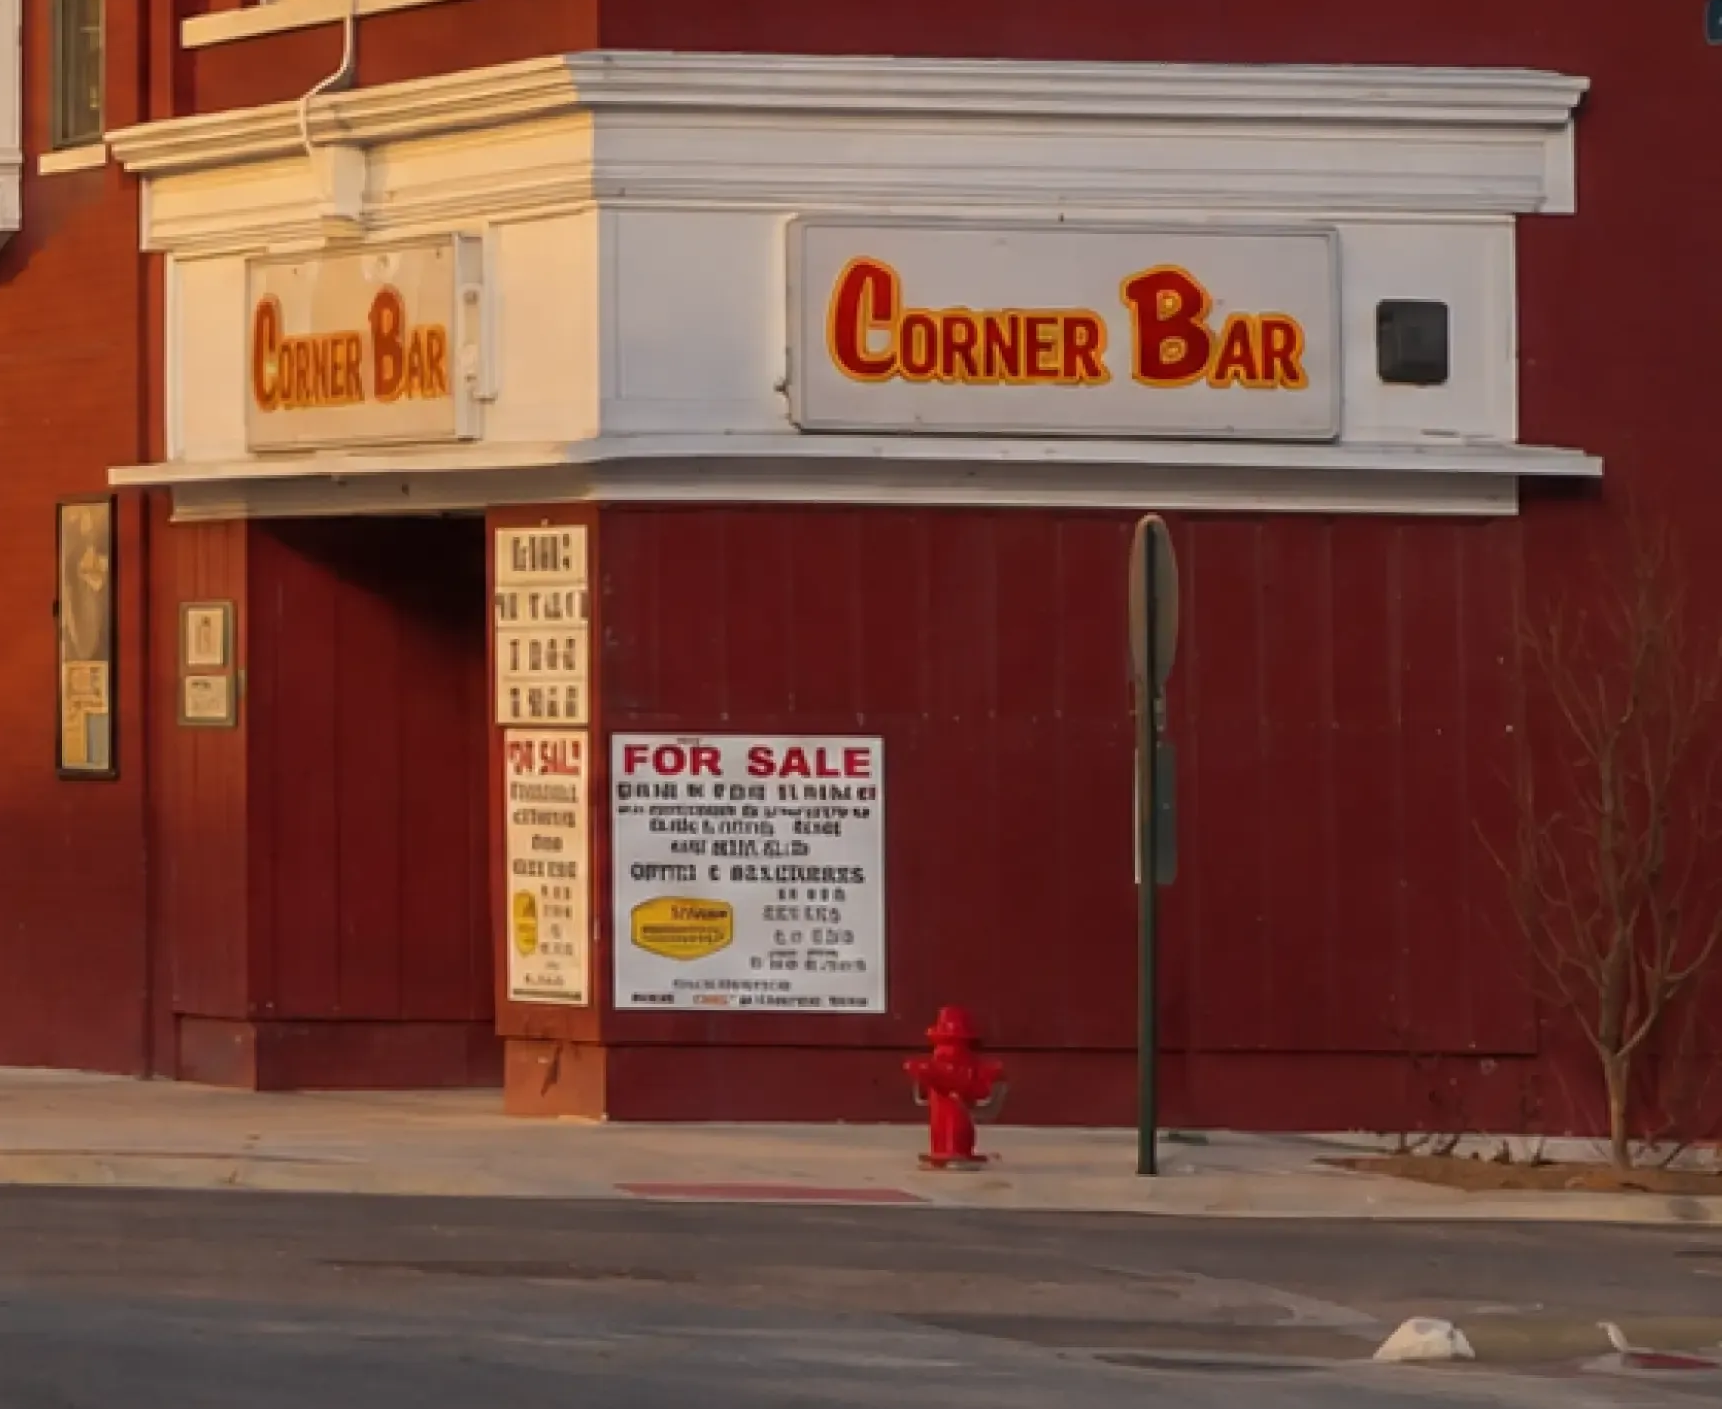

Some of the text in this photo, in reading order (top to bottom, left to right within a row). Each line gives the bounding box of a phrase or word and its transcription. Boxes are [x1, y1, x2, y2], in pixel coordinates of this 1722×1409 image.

[252, 284, 451, 412] CORNER BAR
[827, 256, 1307, 389] CORNER BAR
[623, 744, 872, 779] FOR SALE
